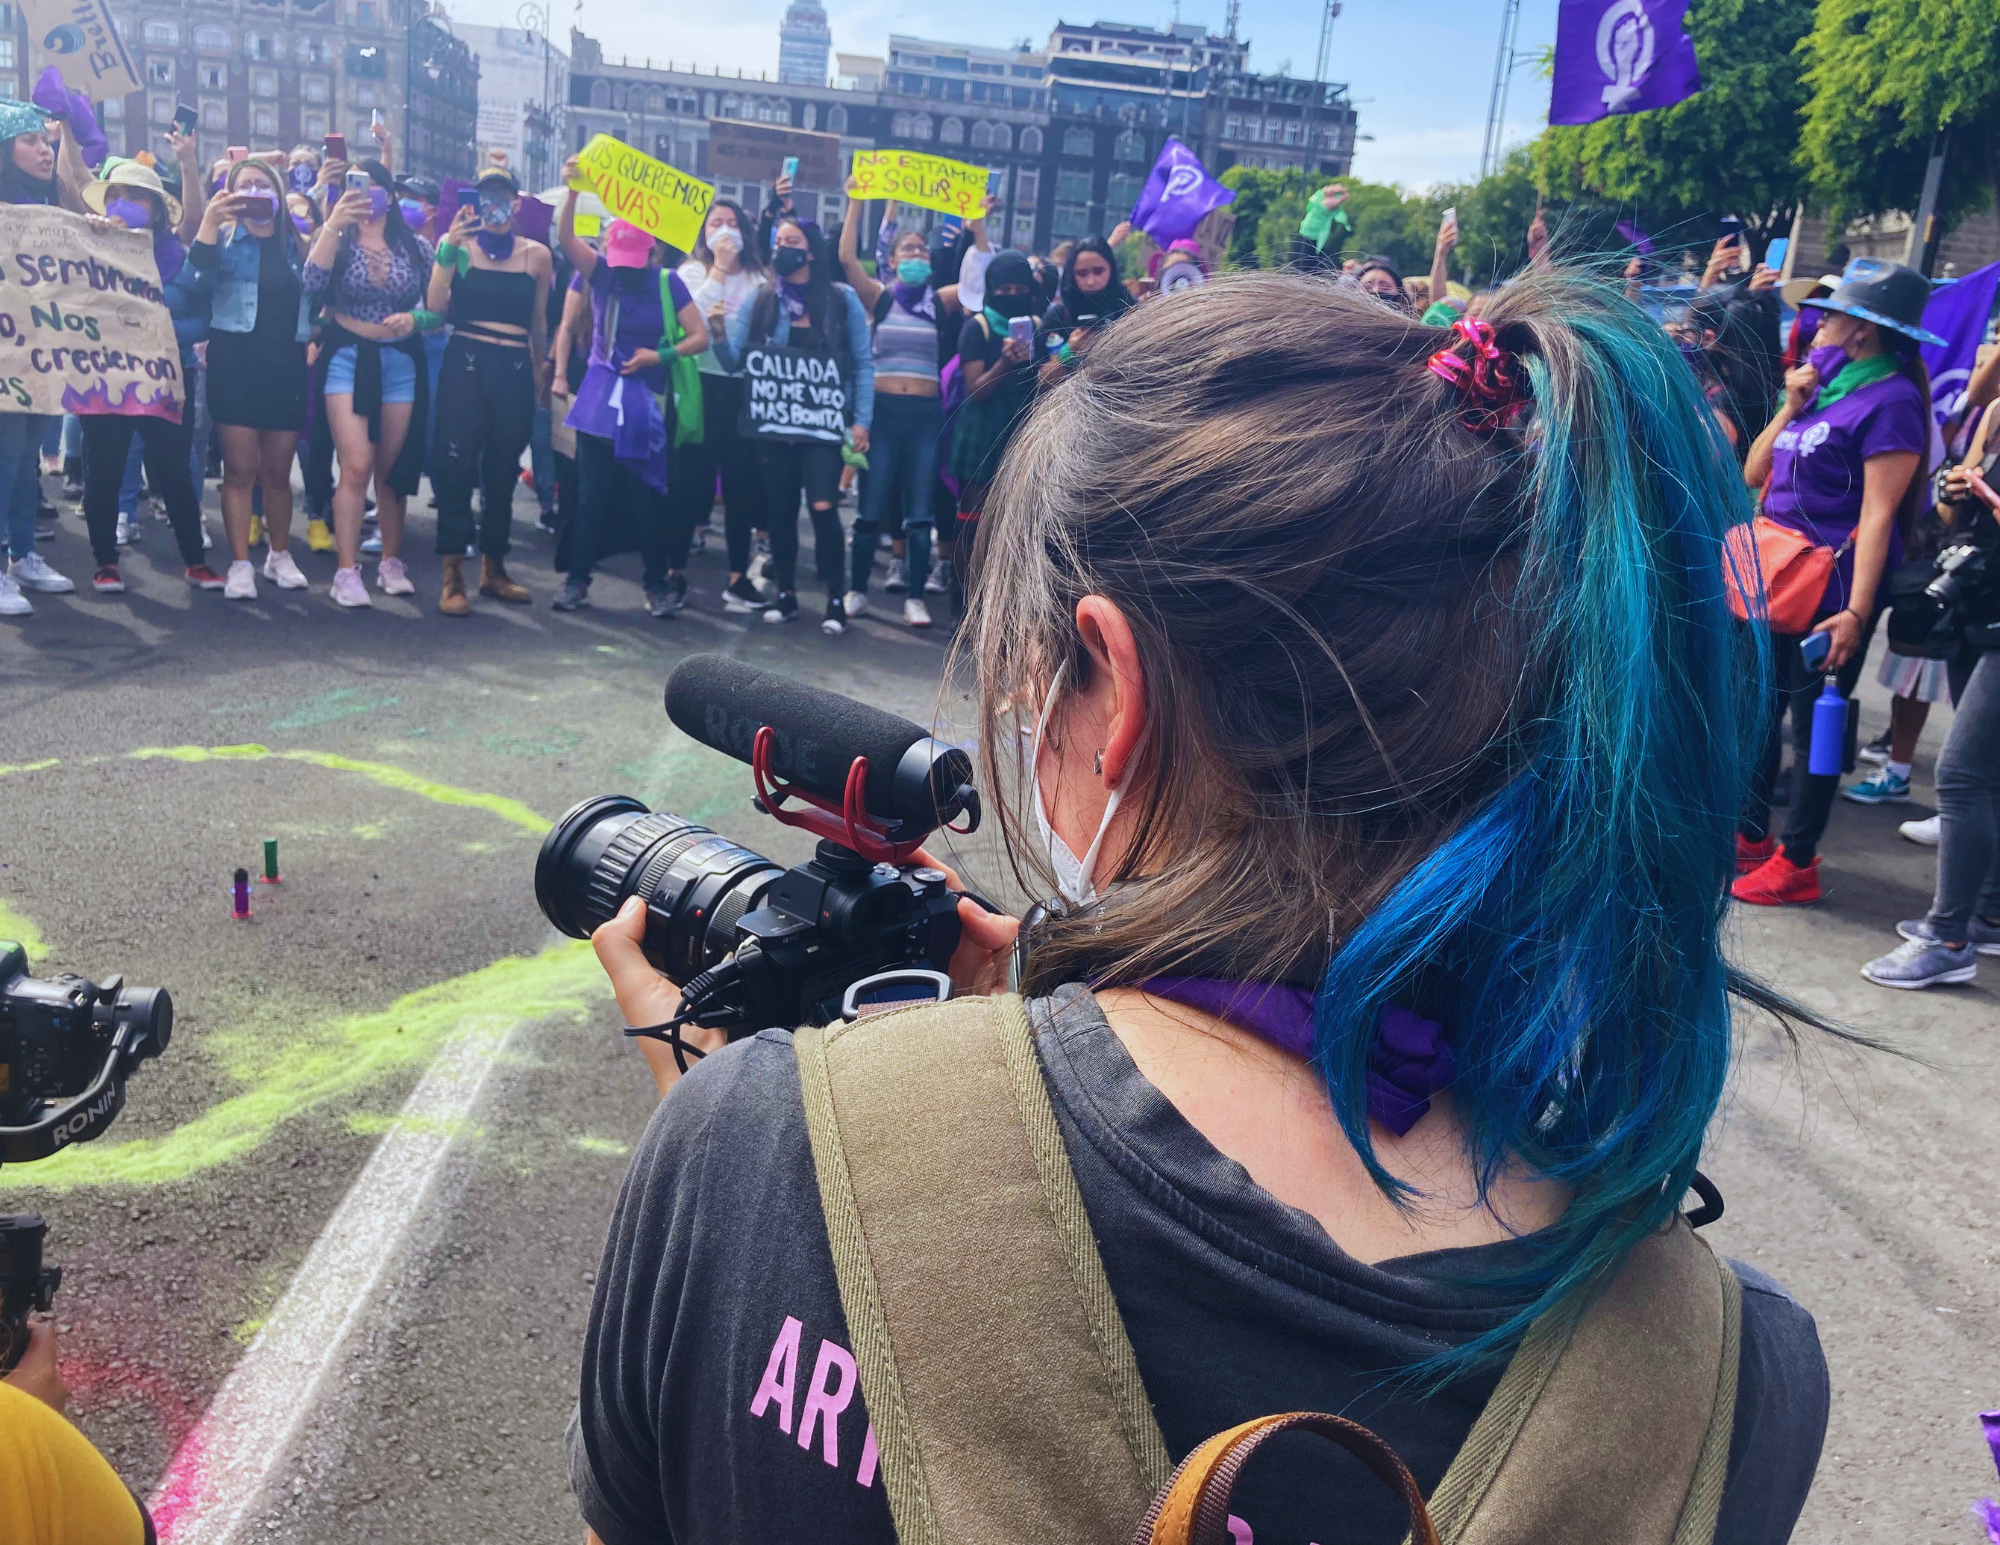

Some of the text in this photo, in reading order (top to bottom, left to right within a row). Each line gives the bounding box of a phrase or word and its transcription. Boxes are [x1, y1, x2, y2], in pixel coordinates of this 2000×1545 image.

[585, 140, 711, 215] OS QUEREMOS
[898, 155, 989, 190] ESTAMOS
[586, 167, 660, 230] VIVAS
[30, 301, 101, 342] Nos
[746, 349, 841, 386] CALLADA
[751, 378, 846, 410] NO ME VEO
[750, 401, 845, 432] MAS BONITA
[53, 1080, 116, 1147] RONIN
